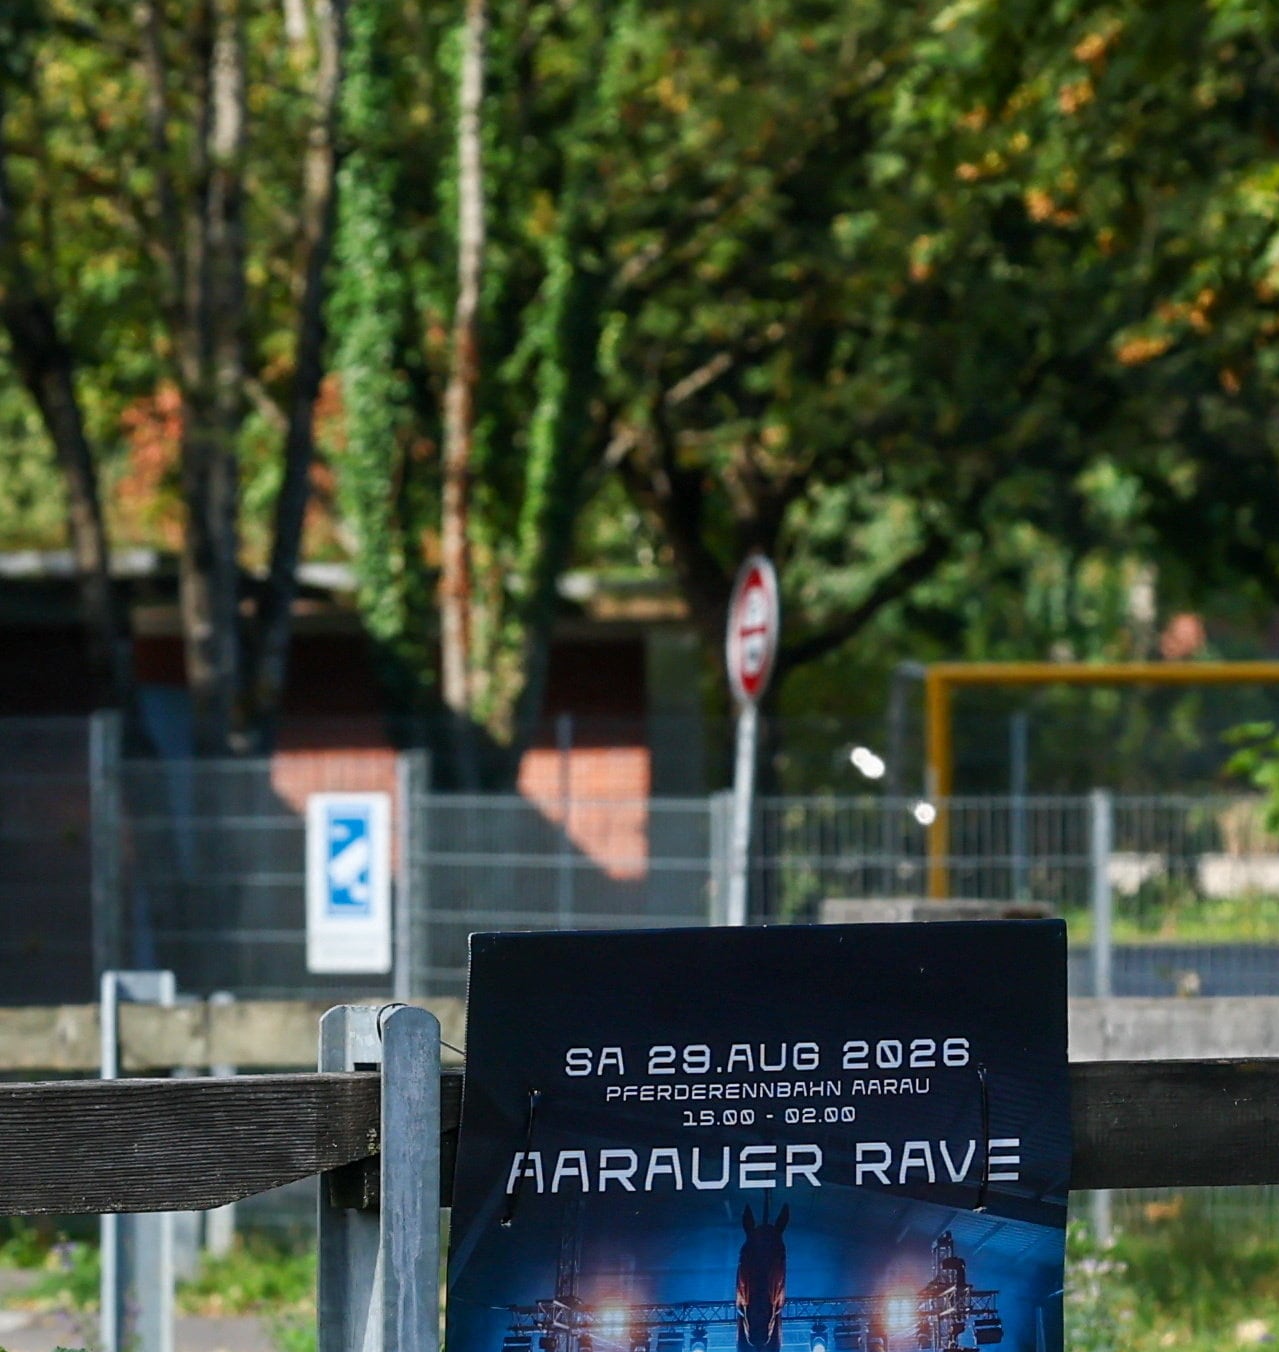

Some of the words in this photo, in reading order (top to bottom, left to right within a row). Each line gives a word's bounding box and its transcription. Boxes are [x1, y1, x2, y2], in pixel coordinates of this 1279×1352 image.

[565, 1047, 624, 1076] SA
[843, 1038, 970, 1070] 2026
[606, 1080, 841, 1102] PFERDERENNBAHN
[852, 1078, 930, 1097] AARAU
[683, 1109, 755, 1127] 15.00
[785, 1106, 855, 1124] 02.00
[506, 1143, 822, 1194] AARAUER
[856, 1138, 1021, 1186] RAVE
